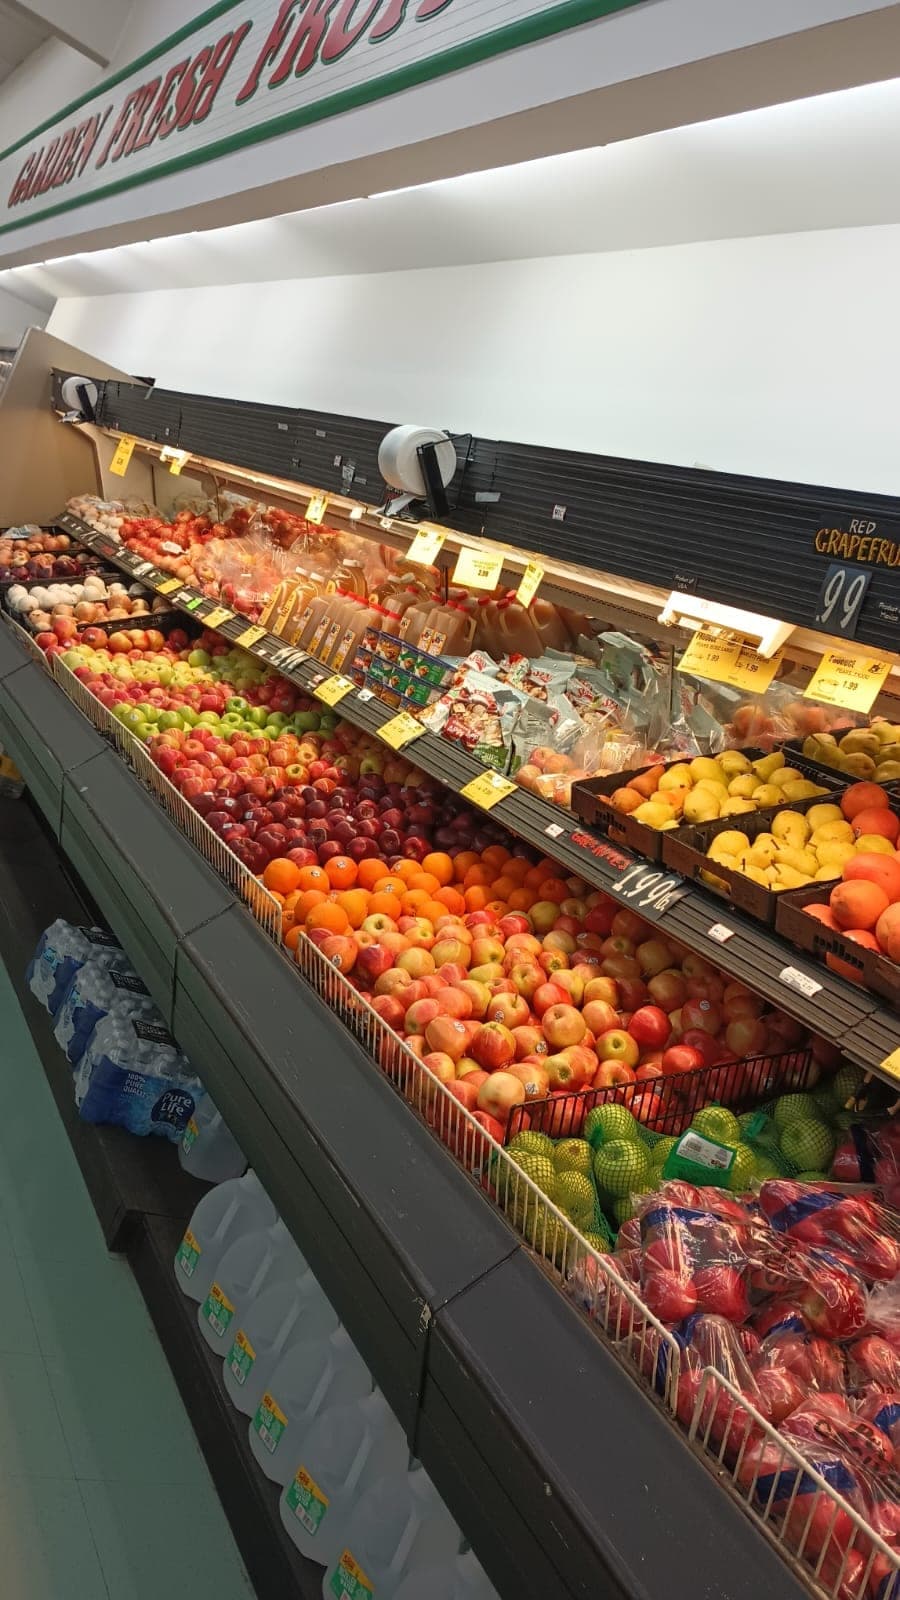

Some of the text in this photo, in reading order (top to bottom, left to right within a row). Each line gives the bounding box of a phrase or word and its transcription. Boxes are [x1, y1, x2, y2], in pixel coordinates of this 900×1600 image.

[7, 103, 114, 210] GARDEN
[94, 19, 254, 170] FRESH
[849, 518, 877, 535] RED
[815, 528, 900, 567] GRAPEFRU
[162, 1092, 192, 1107] Pure
[160, 1101, 185, 1116] Life
